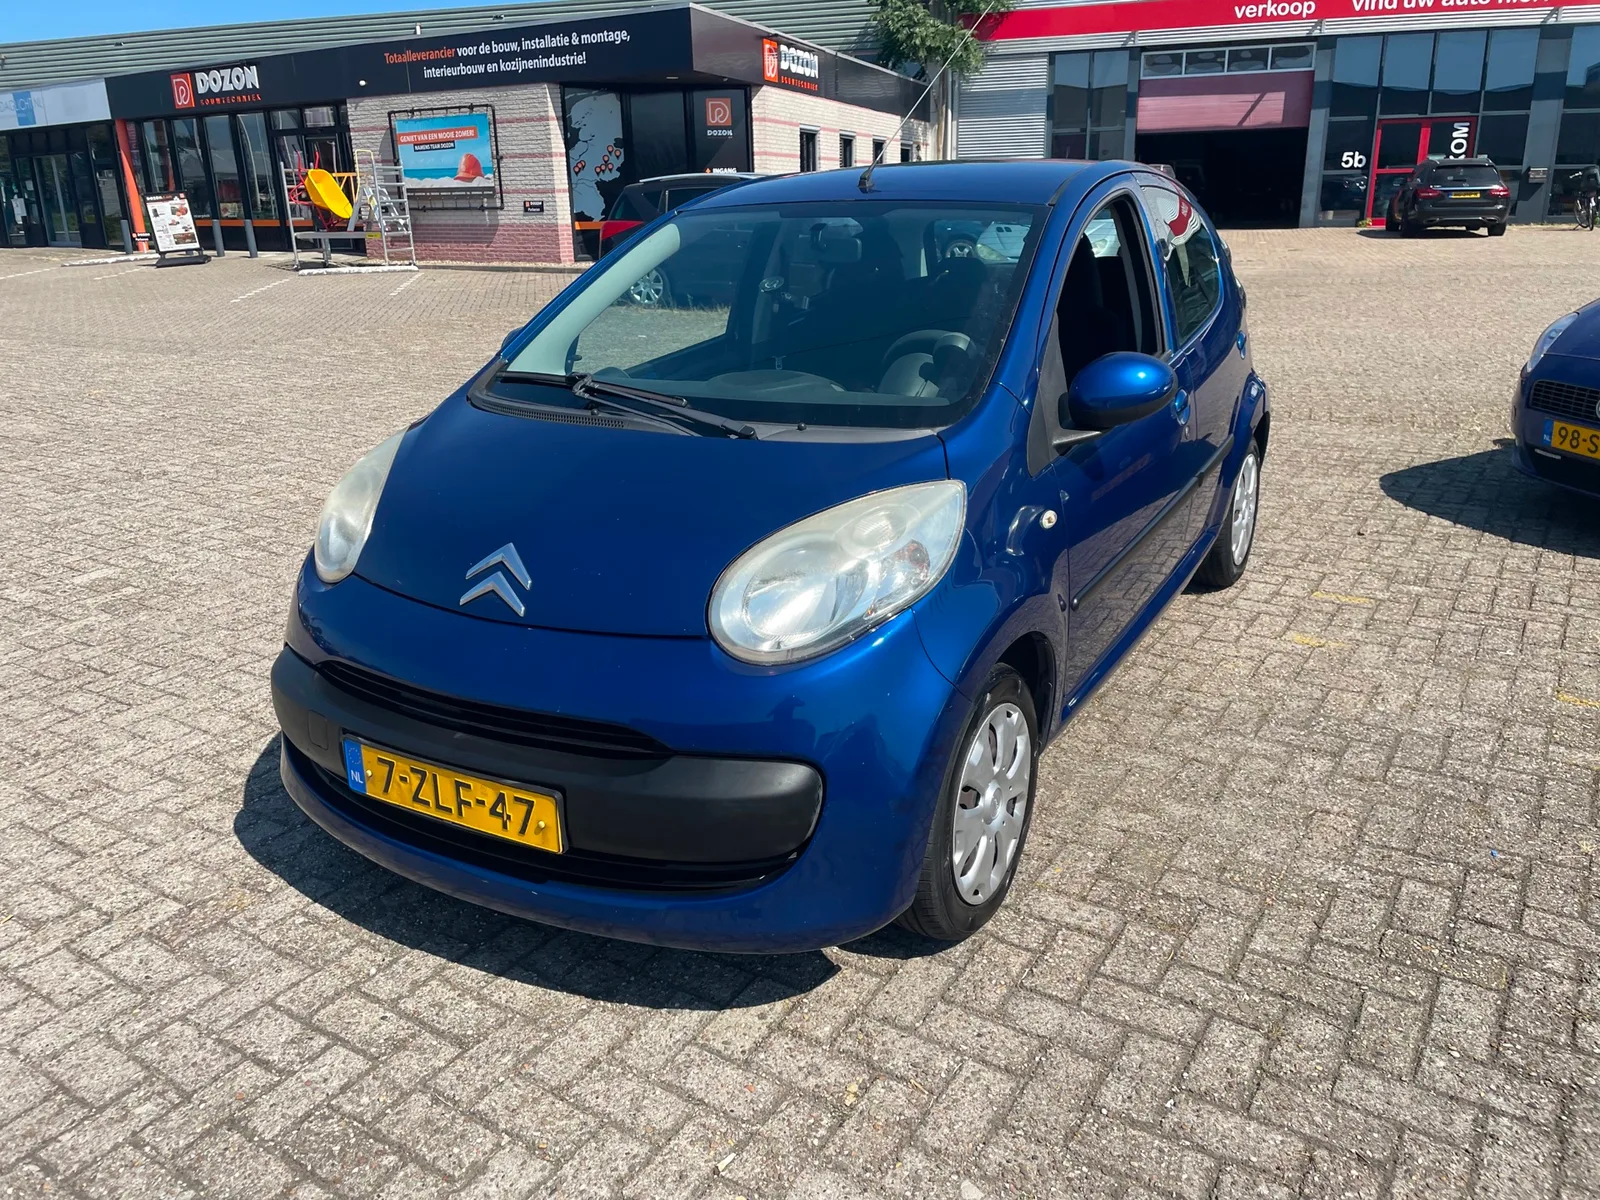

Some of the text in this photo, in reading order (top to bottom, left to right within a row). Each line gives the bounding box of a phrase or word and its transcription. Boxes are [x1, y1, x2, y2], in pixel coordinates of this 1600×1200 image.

[1234, 0, 1316, 18] verkoop
[384, 30, 631, 64] Totaalleverancier voor de bouw, installatie & montage,
[423, 51, 587, 78] interieurbouw en kozijnenindustrie!
[780, 44, 819, 79] DOZON
[195, 65, 260, 94] DOZON
[400, 134, 417, 143] GENIET
[418, 133, 428, 141] VAN
[428, 132, 438, 140] EEN
[438, 131, 455, 139] MOOIE
[1341, 151, 1367, 168] 5b
[1543, 434, 1551, 442] NL
[1558, 426, 1600, 454] 98-S
[350, 770, 364, 784] NL
[377, 755, 536, 836] 7-ZLF-47
